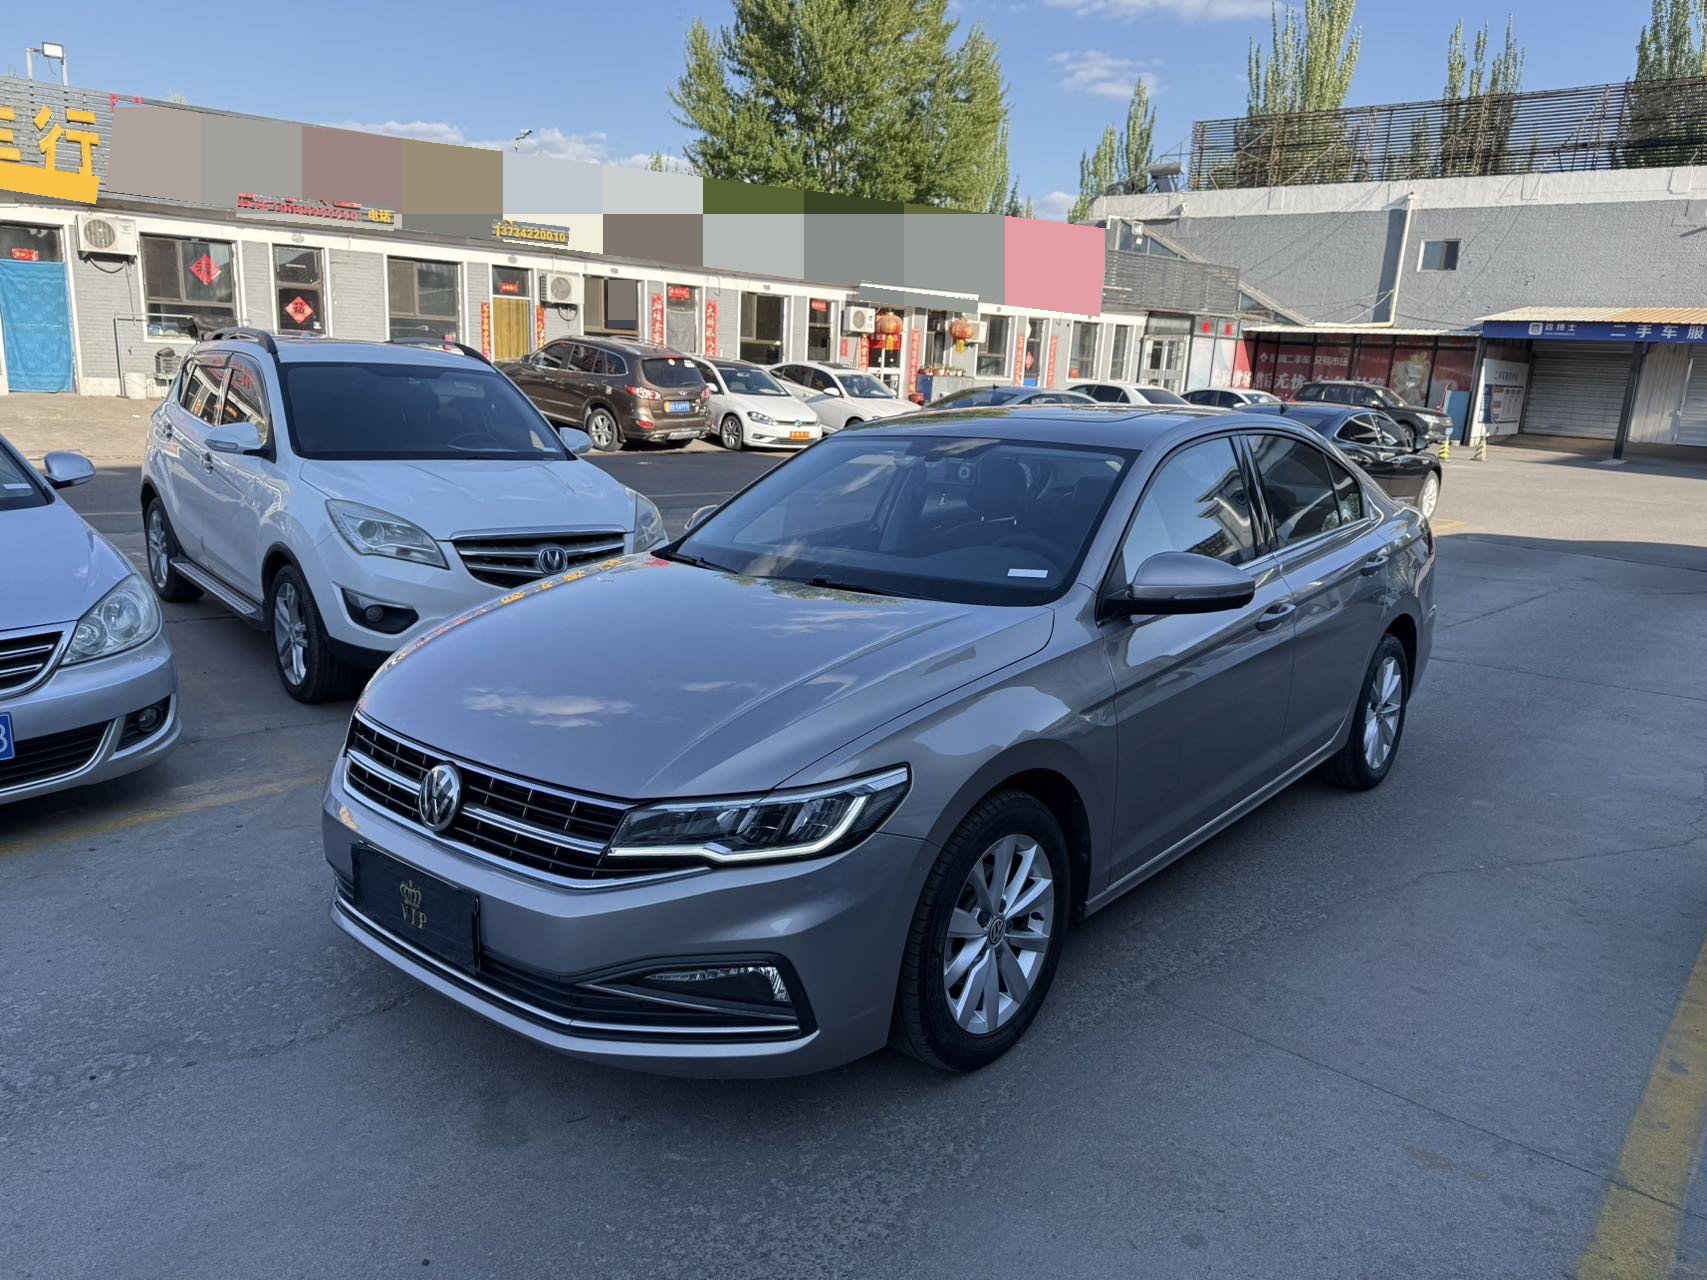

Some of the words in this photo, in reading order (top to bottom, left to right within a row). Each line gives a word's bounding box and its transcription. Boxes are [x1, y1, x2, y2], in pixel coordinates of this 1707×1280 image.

[0, 105, 100, 177] 行
[1610, 324, 1705, 340] 二手车服
[400, 903, 427, 929] VIP
